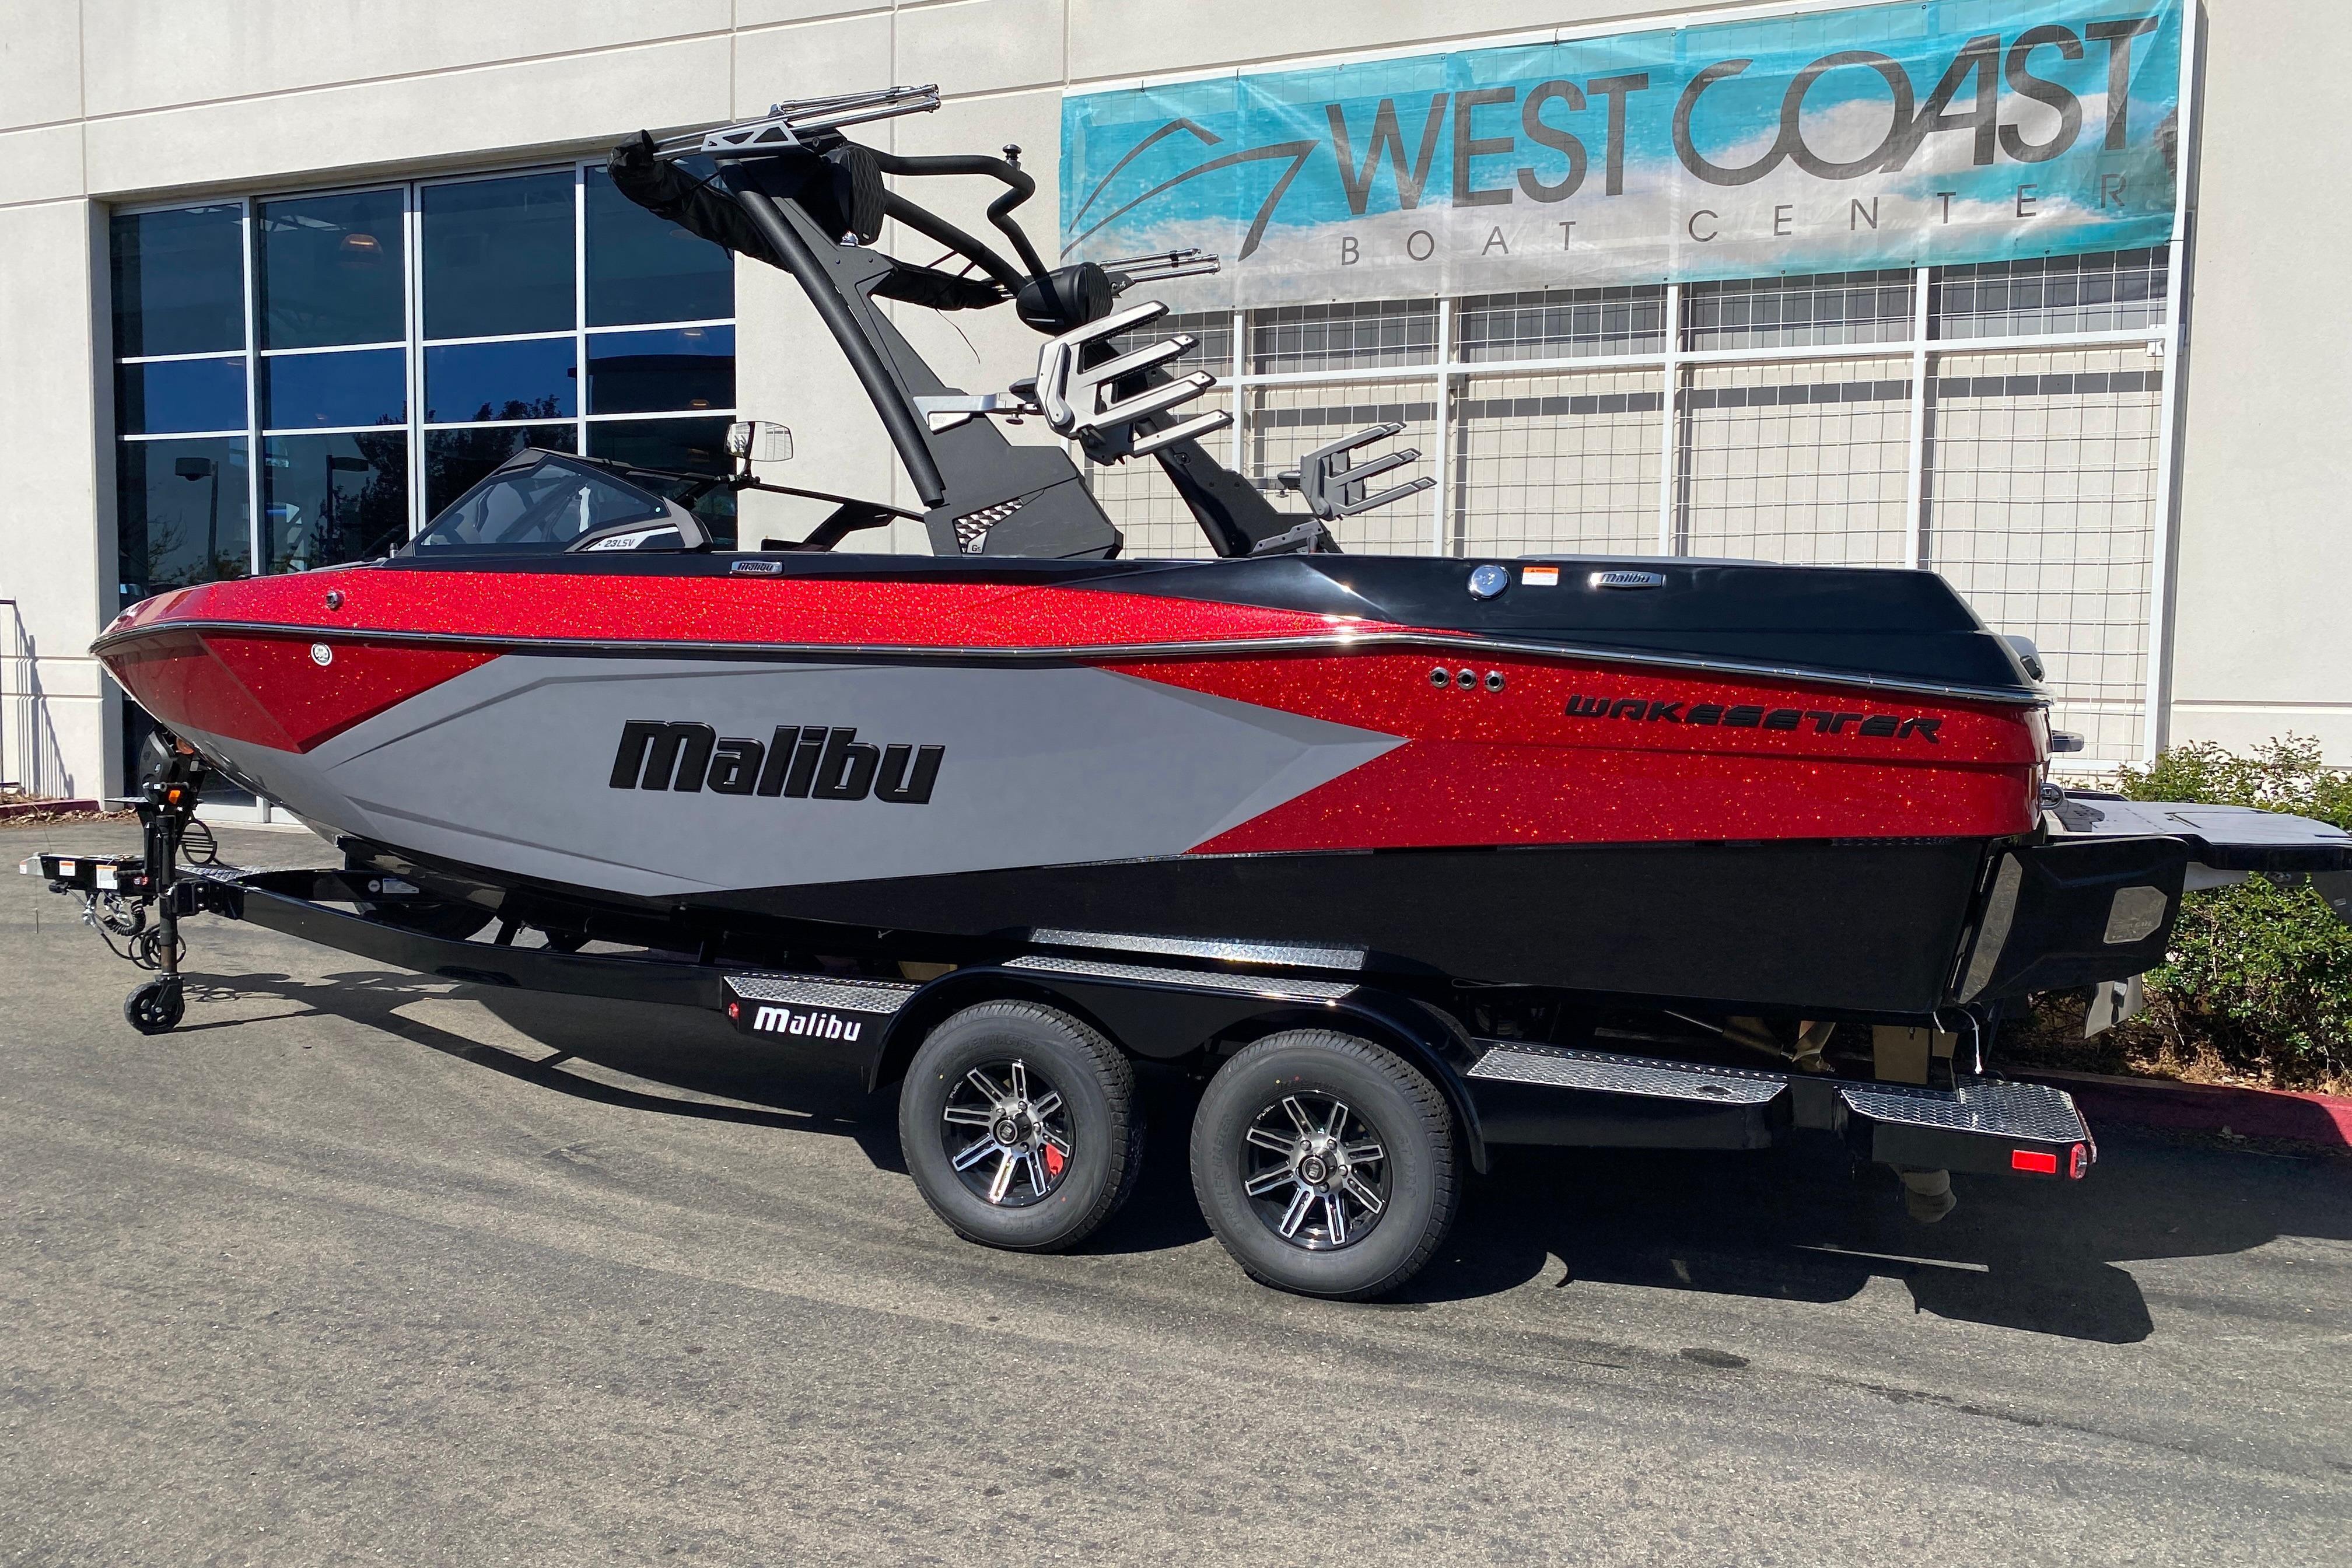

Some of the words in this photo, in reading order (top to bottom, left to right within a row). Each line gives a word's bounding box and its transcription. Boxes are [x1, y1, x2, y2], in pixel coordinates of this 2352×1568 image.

[1326, 72, 1648, 215] WEST
[1672, 15, 2159, 187] COAST
[1341, 221, 1577, 266] BOAT
[1688, 174, 2127, 243] CENTER
[604, 538, 635, 548] 23LSV
[1564, 694, 1943, 744] WAKESETTER
[753, 1006, 861, 1042] Malibu
